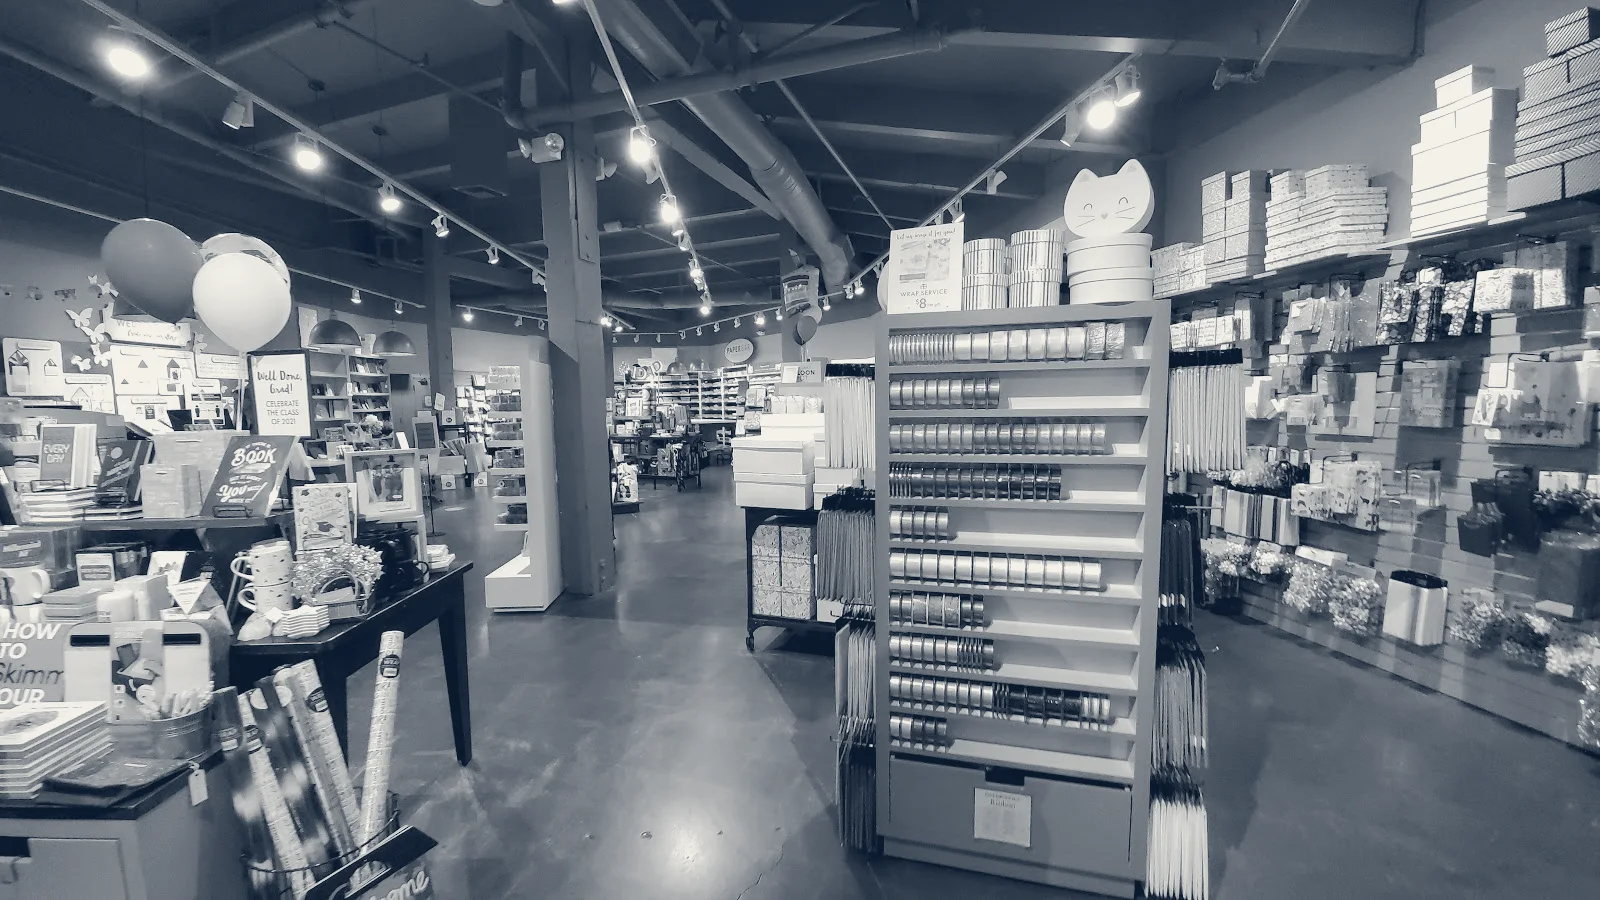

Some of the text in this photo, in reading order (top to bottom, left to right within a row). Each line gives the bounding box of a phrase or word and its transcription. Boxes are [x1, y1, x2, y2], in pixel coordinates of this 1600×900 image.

[915, 297, 927, 309] $8
[257, 370, 303, 381] Well Done,
[270, 383, 293, 394] Grad!
[43, 443, 71, 454] EVERY
[46, 454, 66, 463] DAY
[231, 448, 278, 467] BOOK
[3, 622, 62, 640] HOW
[0, 642, 27, 659] TO
